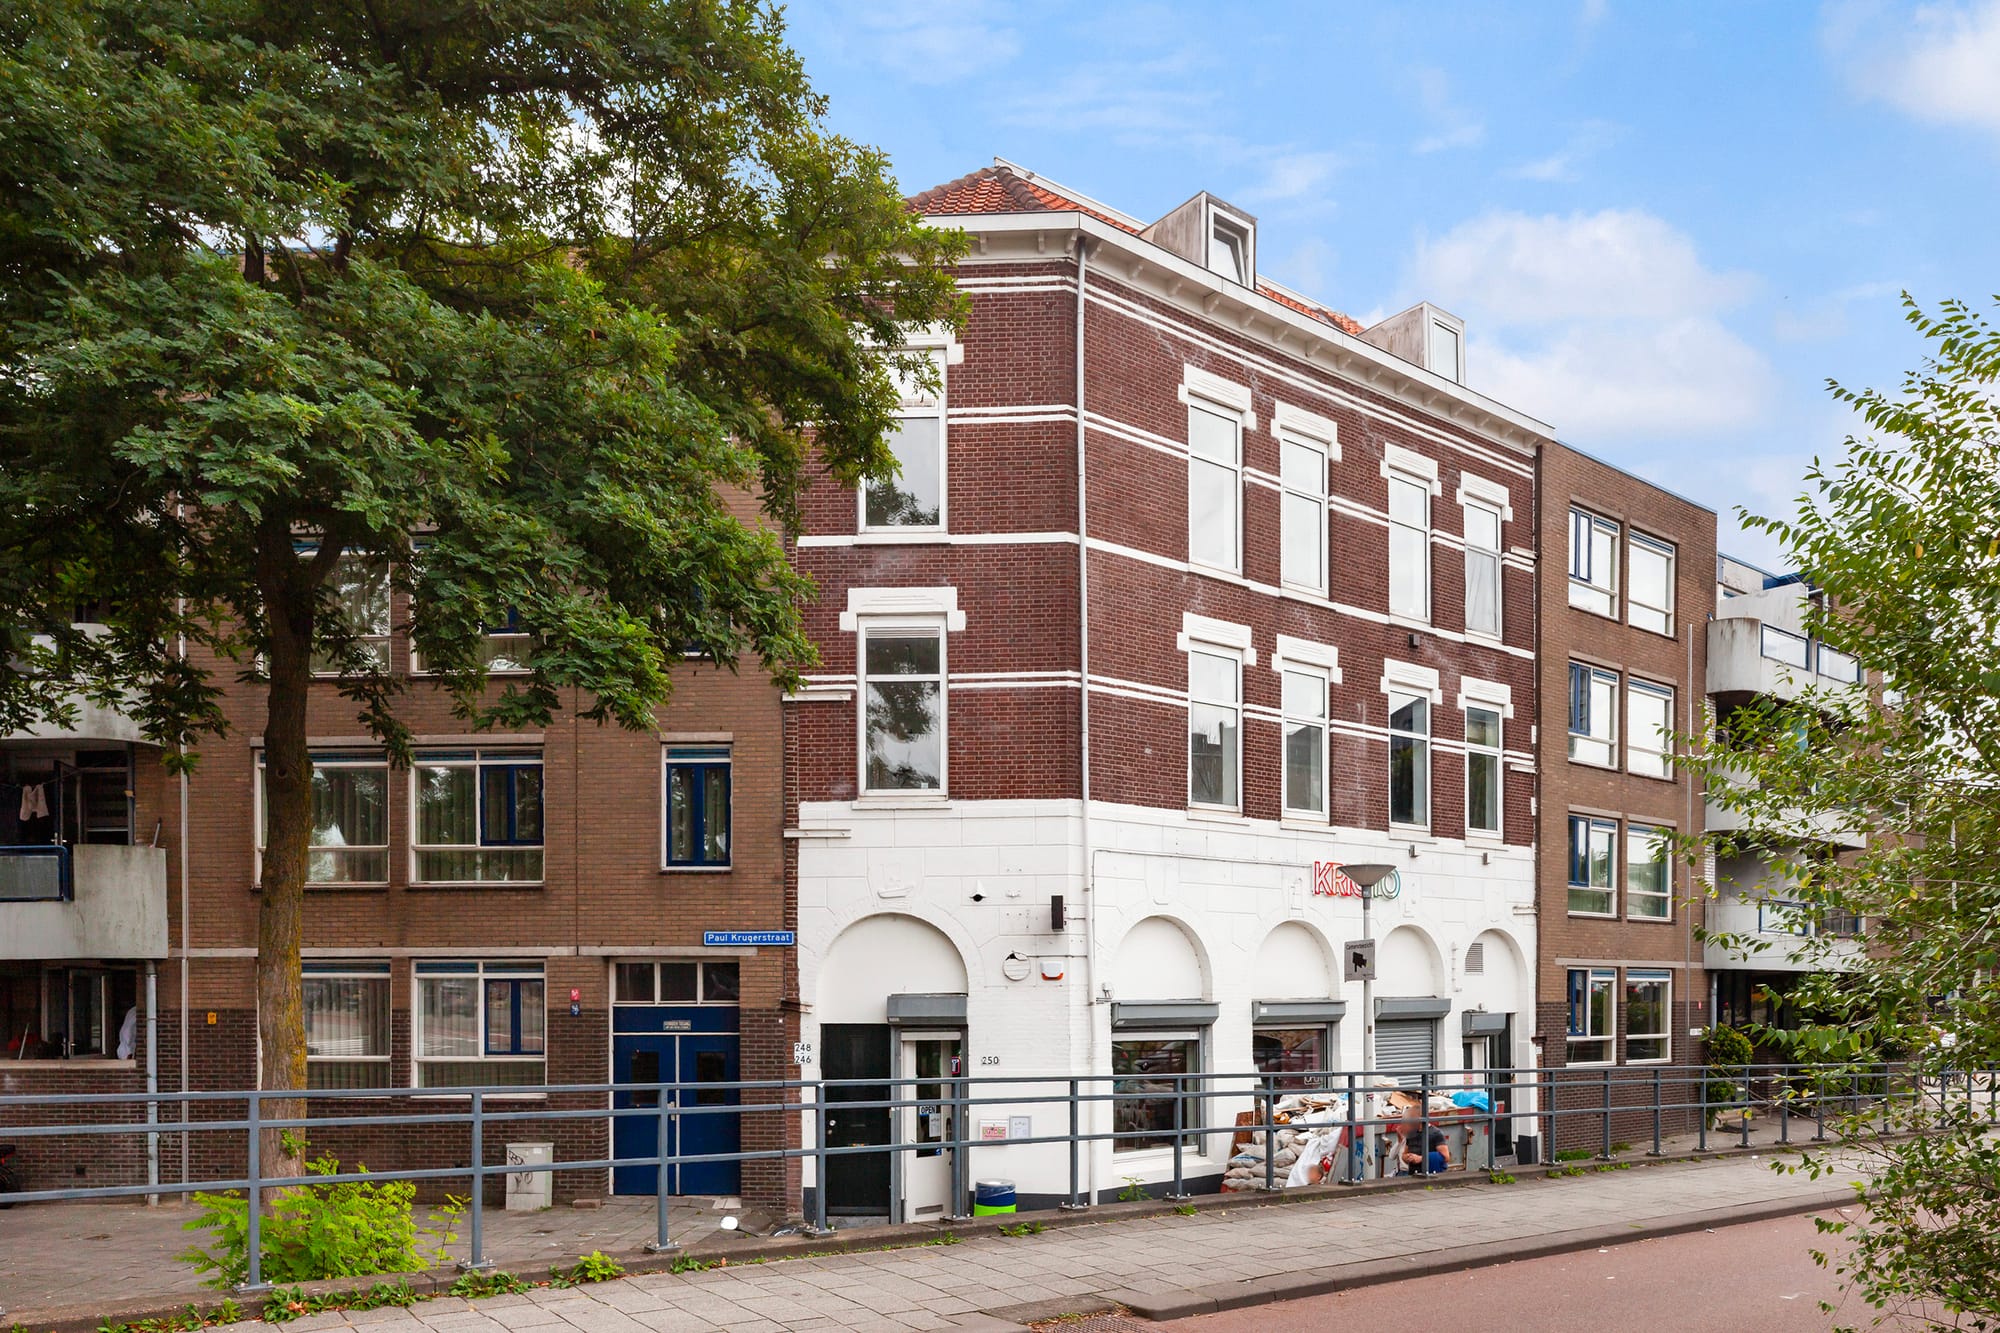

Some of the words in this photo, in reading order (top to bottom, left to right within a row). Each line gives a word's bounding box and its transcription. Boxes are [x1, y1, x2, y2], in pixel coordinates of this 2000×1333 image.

[708, 934, 727, 942] Paul
[731, 934, 790, 943] Krugerstraat
[795, 1043, 812, 1052] 248
[795, 1055, 812, 1064] 246
[982, 1056, 999, 1064] 250
[921, 1106, 936, 1114] OPEN
